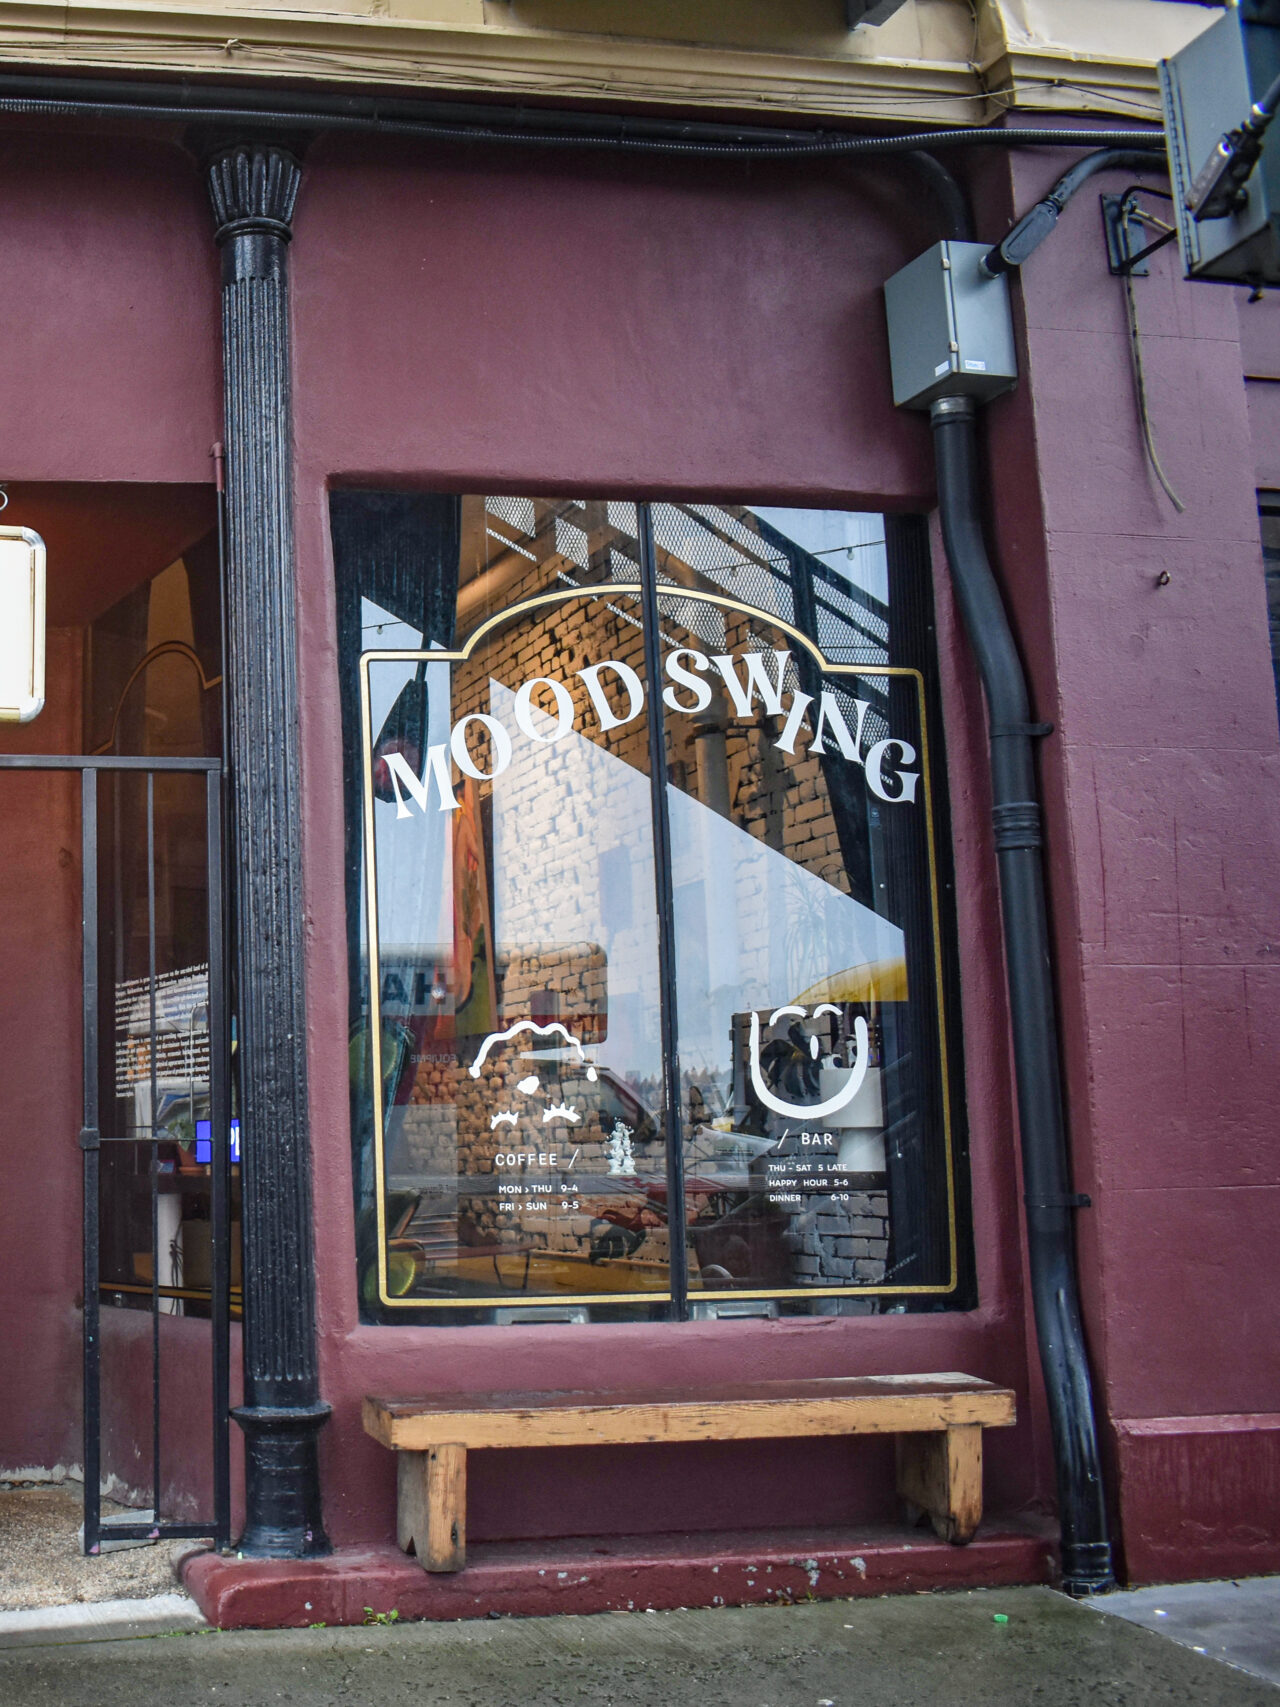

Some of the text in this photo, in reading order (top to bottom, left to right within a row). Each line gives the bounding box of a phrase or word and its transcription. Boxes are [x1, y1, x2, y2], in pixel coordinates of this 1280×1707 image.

[801, 1132, 833, 1146] BAR
[495, 1153, 558, 1167] COFFEE
[768, 1164, 786, 1172] THU
[795, 1164, 812, 1172] SAT
[818, 1164, 824, 1172] 5
[827, 1163, 848, 1171] LATE
[769, 1178, 849, 1187] HAPPY HOUR 5-6
[498, 1185, 522, 1194] MON
[531, 1184, 552, 1193] THU
[560, 1184, 578, 1193] 9-4
[769, 1193, 850, 1202] DINNER 6-10
[499, 1202, 515, 1211] FRI
[526, 1201, 547, 1210] SUN
[561, 1200, 579, 1210] 9-5
